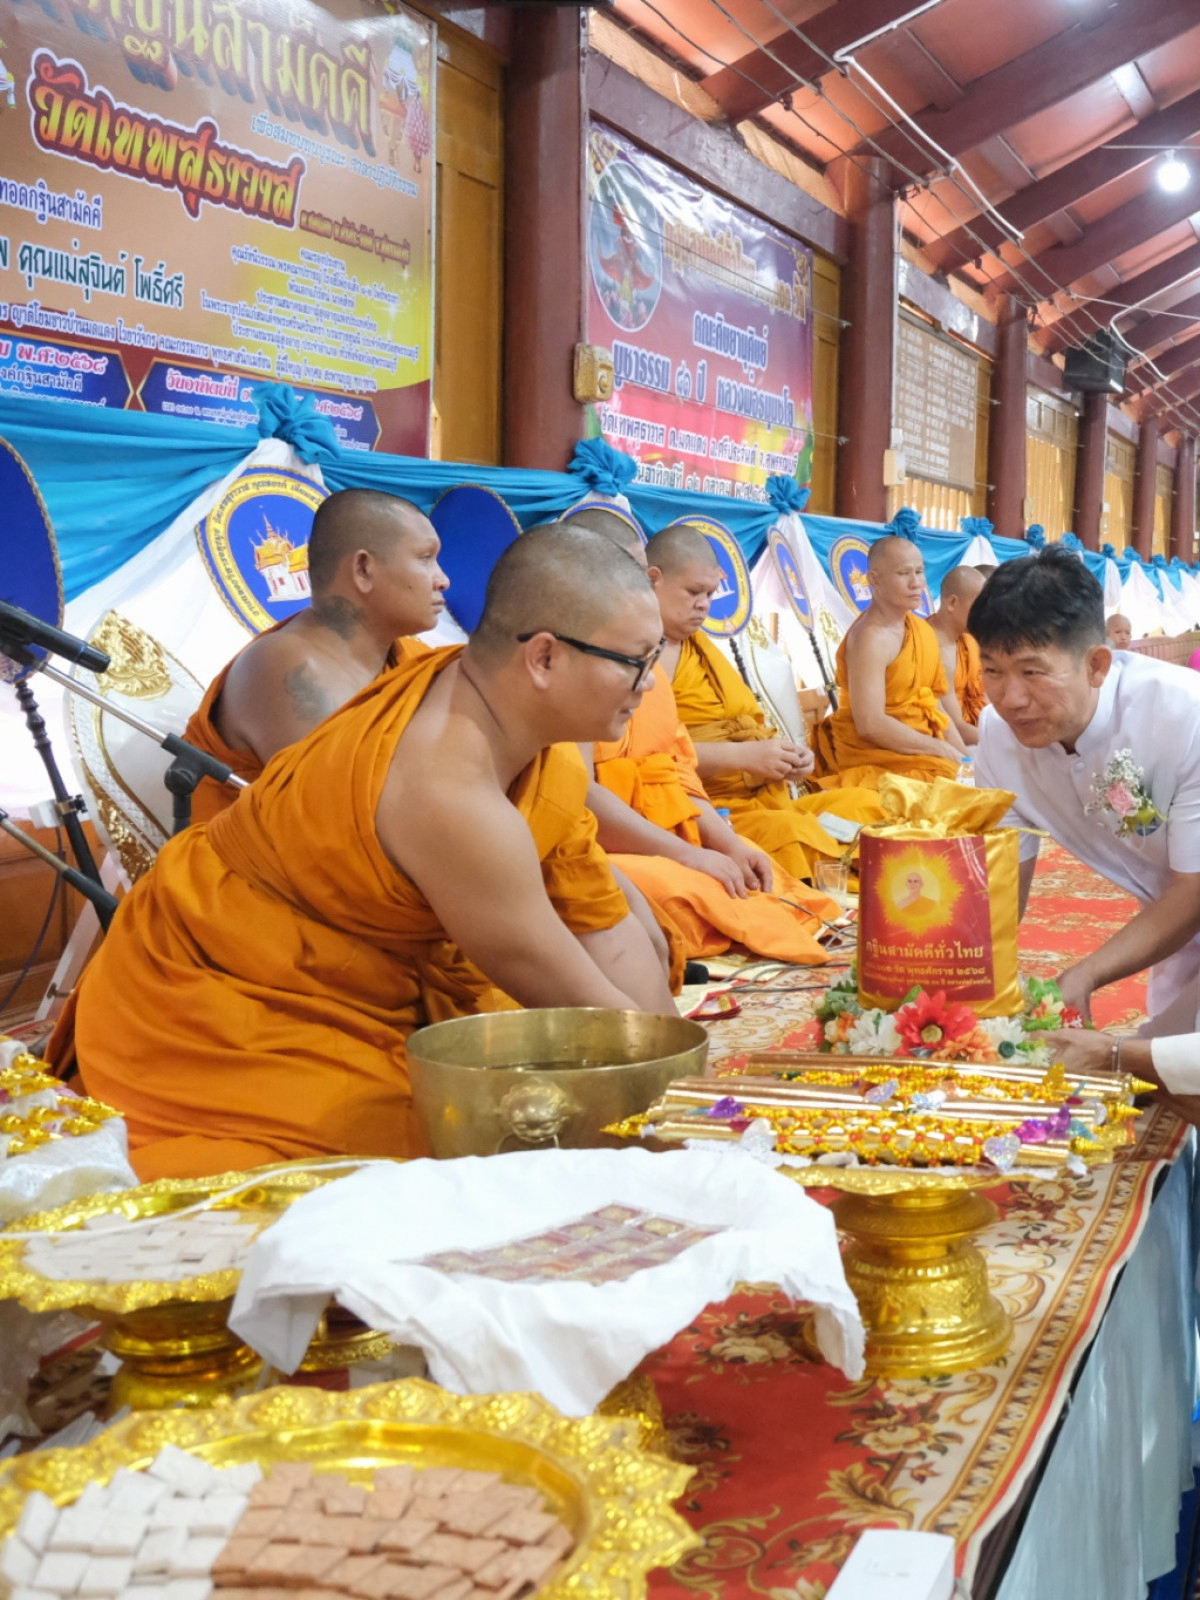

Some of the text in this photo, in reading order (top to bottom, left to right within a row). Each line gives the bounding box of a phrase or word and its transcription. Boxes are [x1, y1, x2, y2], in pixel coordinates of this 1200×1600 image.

[33, 60, 304, 216] วัดเทพสุธาวาส
[19, 241, 125, 301] คุณแม่สุจินต์
[134, 258, 183, 308] โพธิ์ศรี
[613, 341, 671, 390] บูชาธรรม
[866, 939, 985, 959] กฐินสามัคคีทั่วไทย
